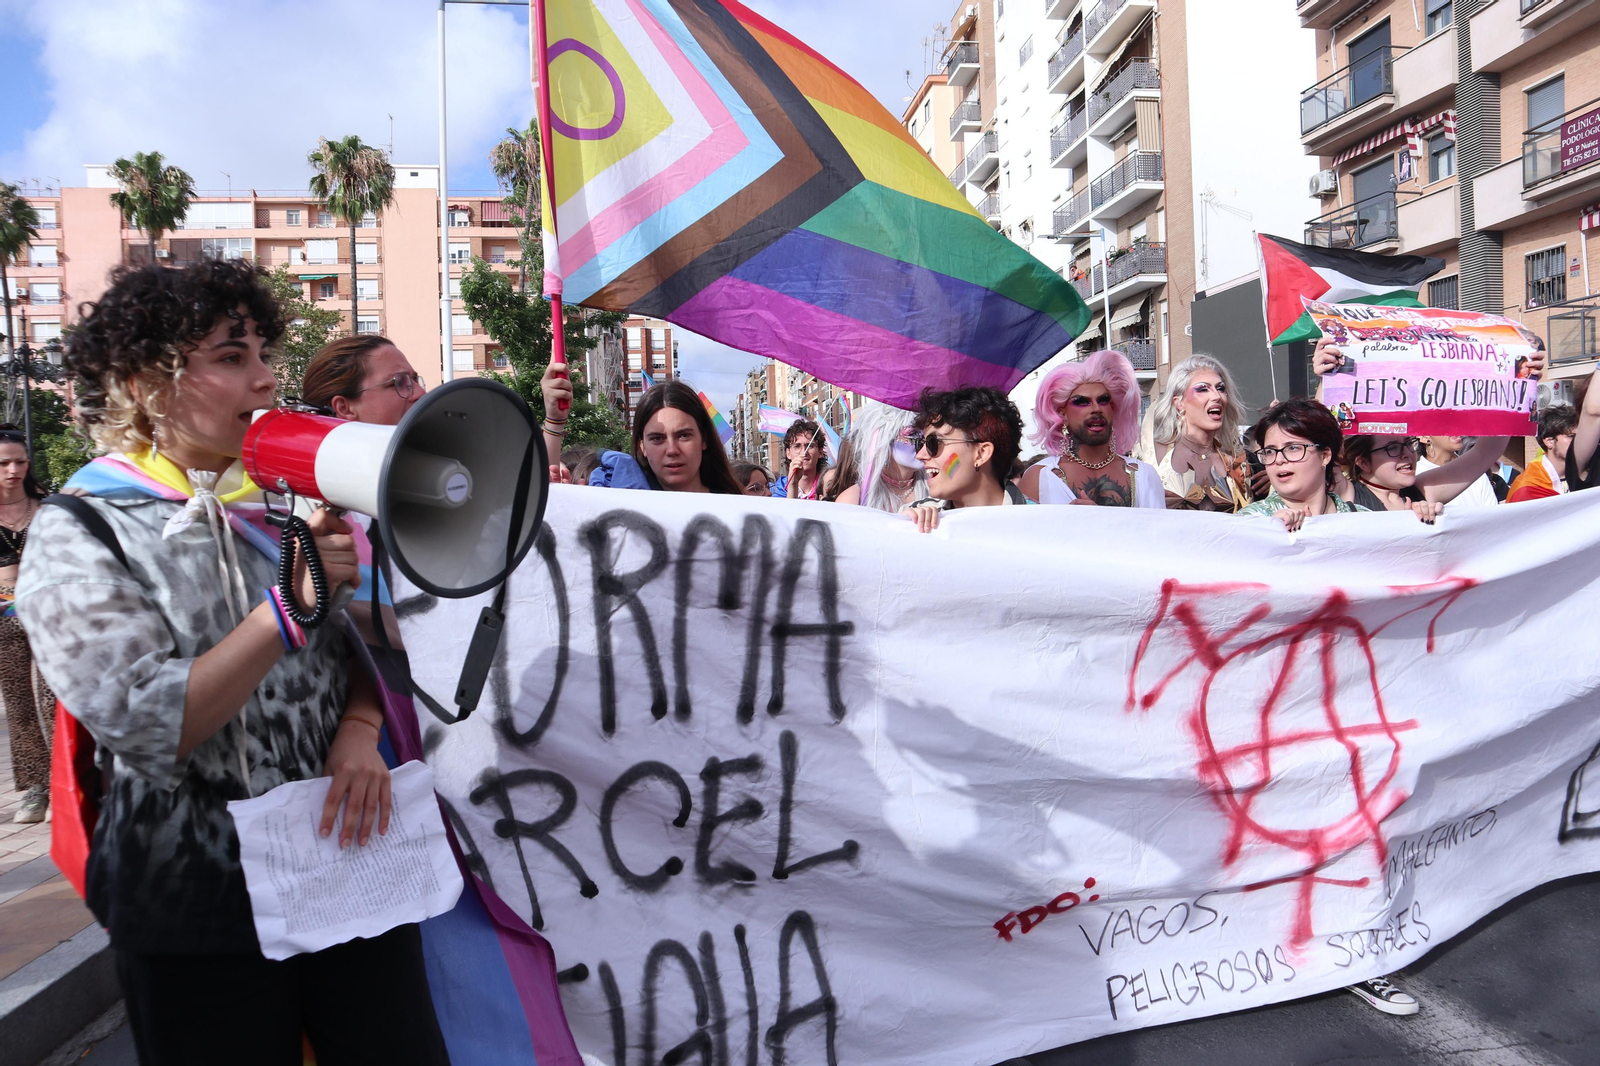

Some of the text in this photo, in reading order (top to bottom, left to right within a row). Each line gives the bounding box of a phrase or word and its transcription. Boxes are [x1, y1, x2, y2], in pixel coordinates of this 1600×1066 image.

[1353, 377, 1528, 412] LET'S GO LESBIANS!
[384, 508, 856, 748] ORMA
[1078, 890, 1230, 956] VAGOS,
[1105, 944, 1296, 1021] PELIGROSOS
